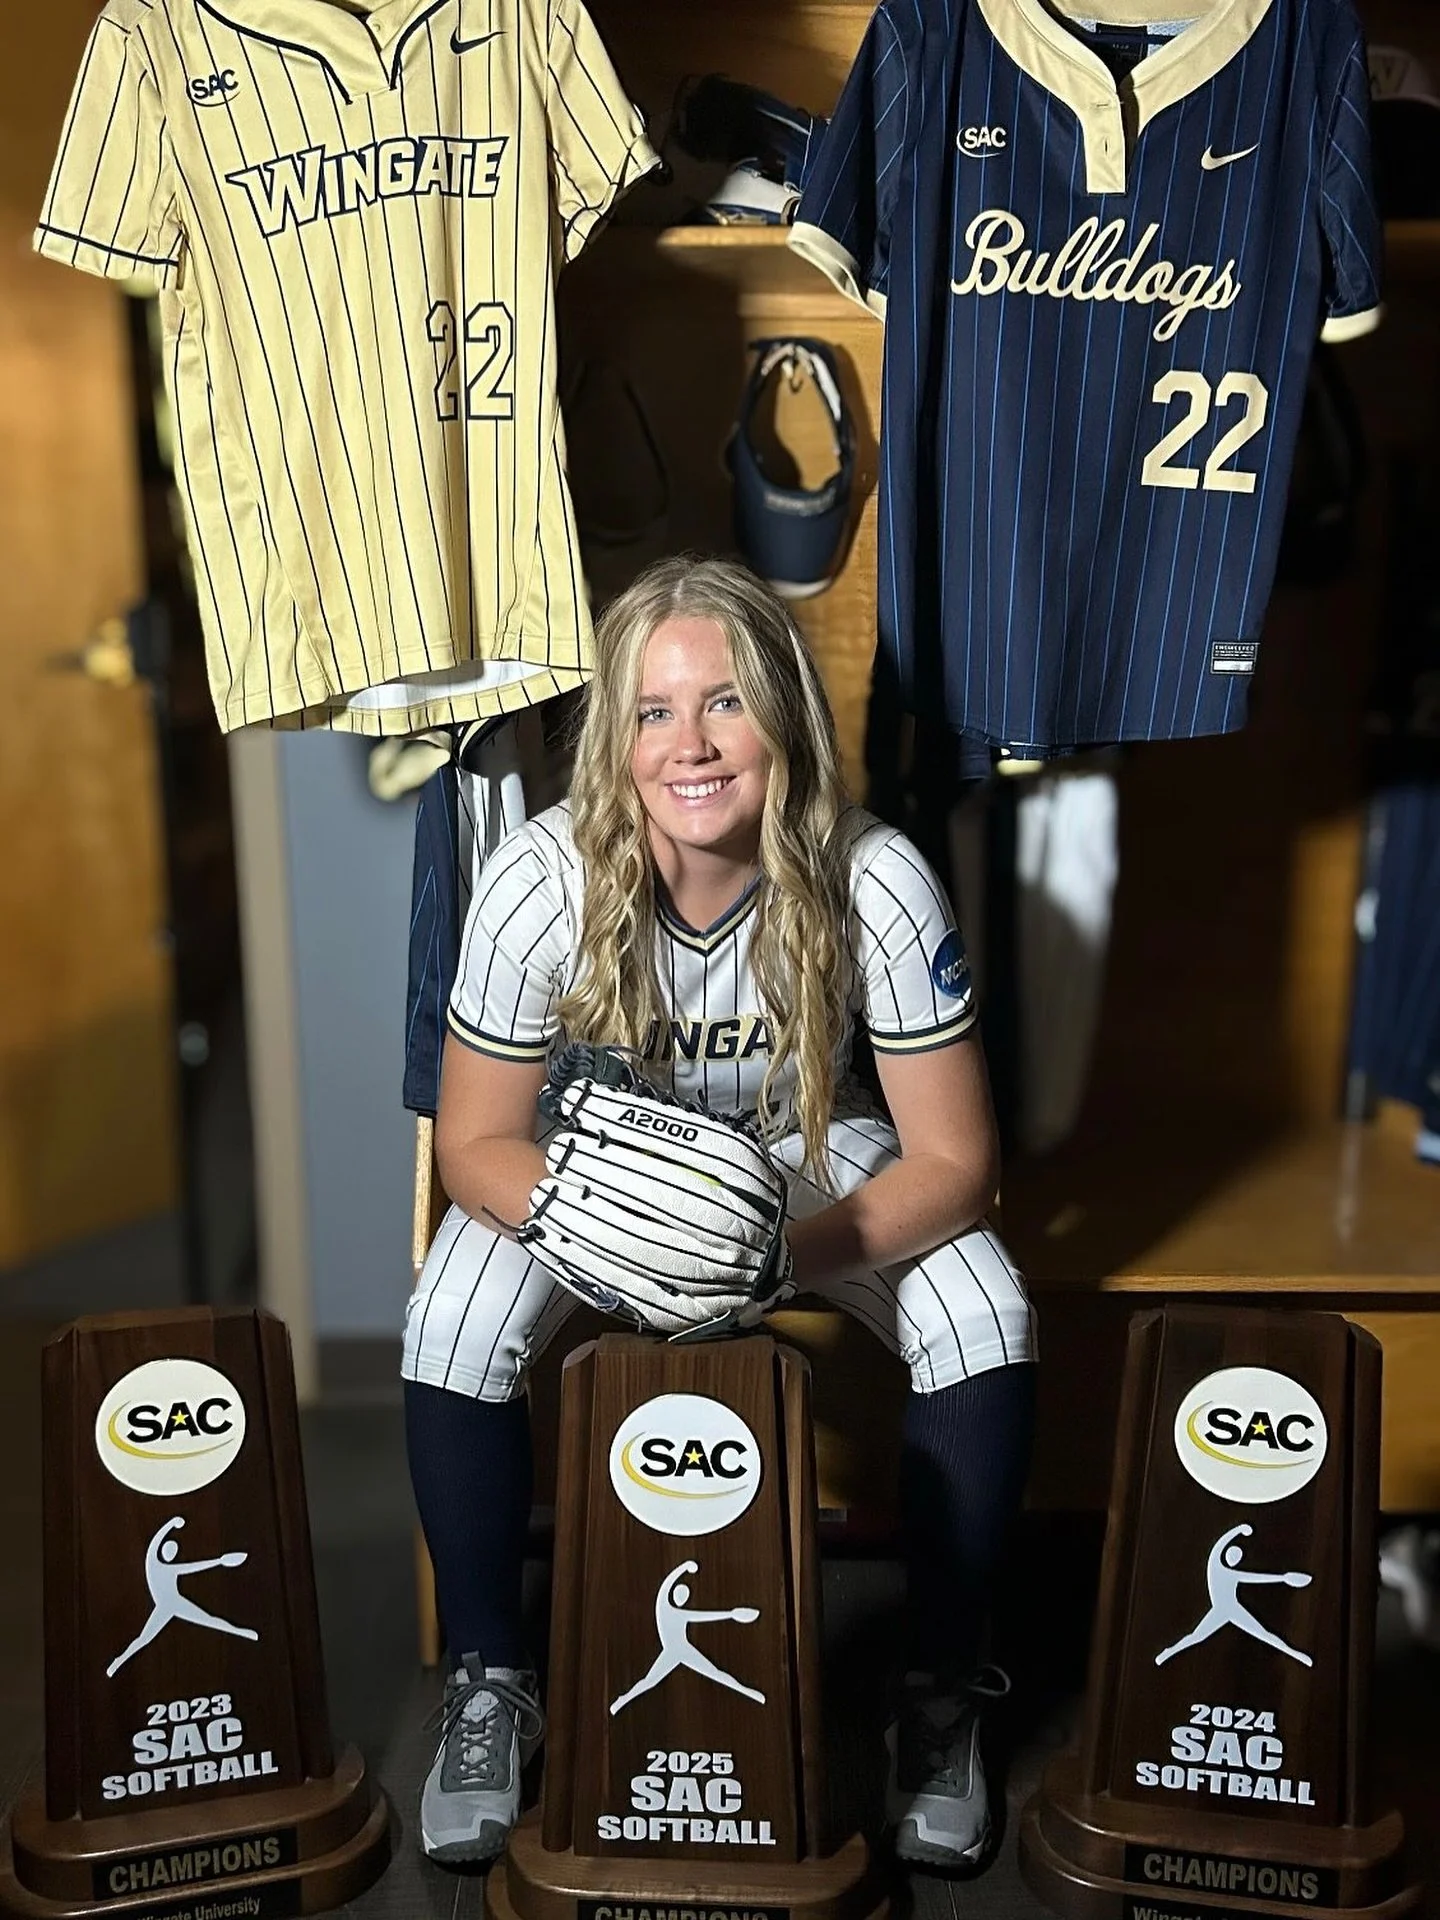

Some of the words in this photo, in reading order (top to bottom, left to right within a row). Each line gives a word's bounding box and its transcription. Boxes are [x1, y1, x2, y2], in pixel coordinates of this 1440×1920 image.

[192, 69, 239, 101] SAC
[963, 126, 1007, 151] SAC
[225, 136, 510, 238] WINGATE
[951, 210, 1241, 341] Bulldogs
[426, 301, 514, 420] 22
[1141, 369, 1268, 493] 22
[618, 1108, 699, 1142] A2000
[126, 1397, 233, 1443] SAC
[1204, 1407, 1315, 1452] SAC
[639, 1438, 748, 1479] SAC
[146, 1693, 232, 1725] 2023
[1189, 1703, 1276, 1733] 2024
[132, 1716, 243, 1764] SAC
[646, 1750, 734, 1774] 2025
[1170, 1726, 1283, 1771] SAC
[101, 1751, 279, 1800] SOFTBALL
[631, 1775, 742, 1813] SAC
[1135, 1761, 1316, 1806] SOFTBALL
[597, 1815, 776, 1846] SOFTBALL
[109, 1836, 280, 1894] CHAMPIONS
[1143, 1852, 1319, 1900] CHAMPIONS
